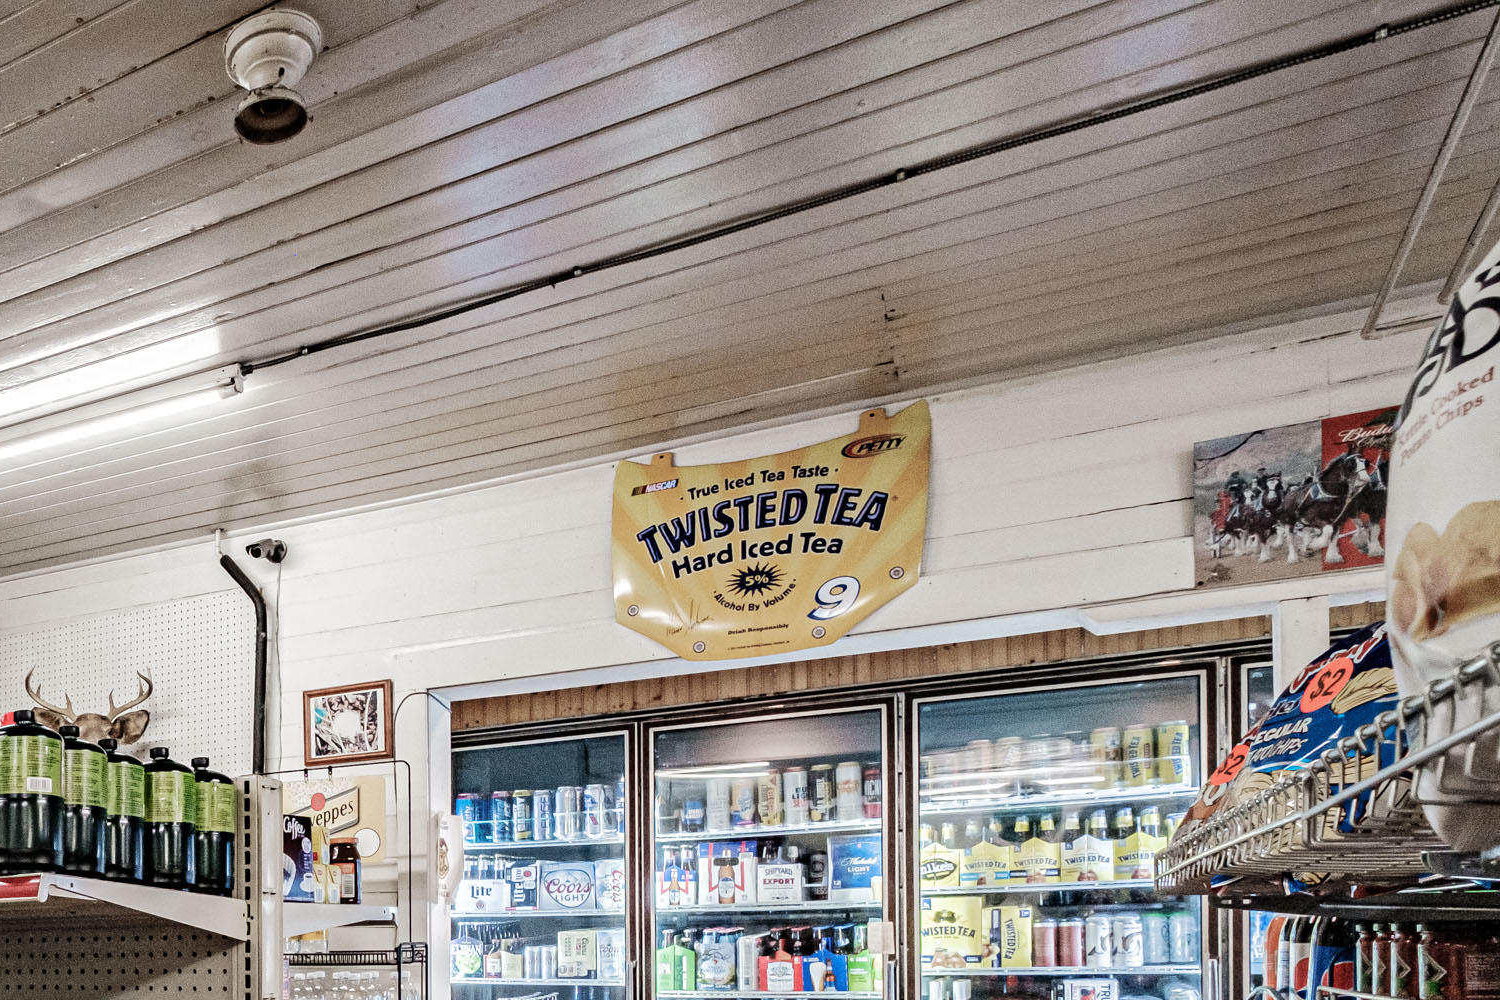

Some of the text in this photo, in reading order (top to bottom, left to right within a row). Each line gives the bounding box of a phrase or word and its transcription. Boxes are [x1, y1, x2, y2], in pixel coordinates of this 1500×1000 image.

[1431, 367, 1494, 415] Cooked
[1436, 394, 1484, 430] Chips
[857, 435, 907, 453] PETTY
[644, 478, 679, 495] NASCAR
[688, 464, 829, 499] True Iced Tea Taste
[636, 484, 889, 564] TWISTED TEA
[671, 532, 843, 579] Hard Iced Tea
[745, 573, 769, 586] 5%
[715, 581, 796, 612] Alcohol By Volume
[808, 575, 860, 620] 9
[1310, 668, 1346, 700] $2
[283, 816, 305, 841] Coffee
[1096, 854, 1110, 863] TEA
[470, 886, 492, 898] Lite
[546, 879, 591, 895] Coors
[611, 870, 623, 903] Coors
[763, 877, 795, 886] EXPORT
[957, 926, 976, 938] TEA
[1004, 918, 1016, 960] TWISTED TEA
